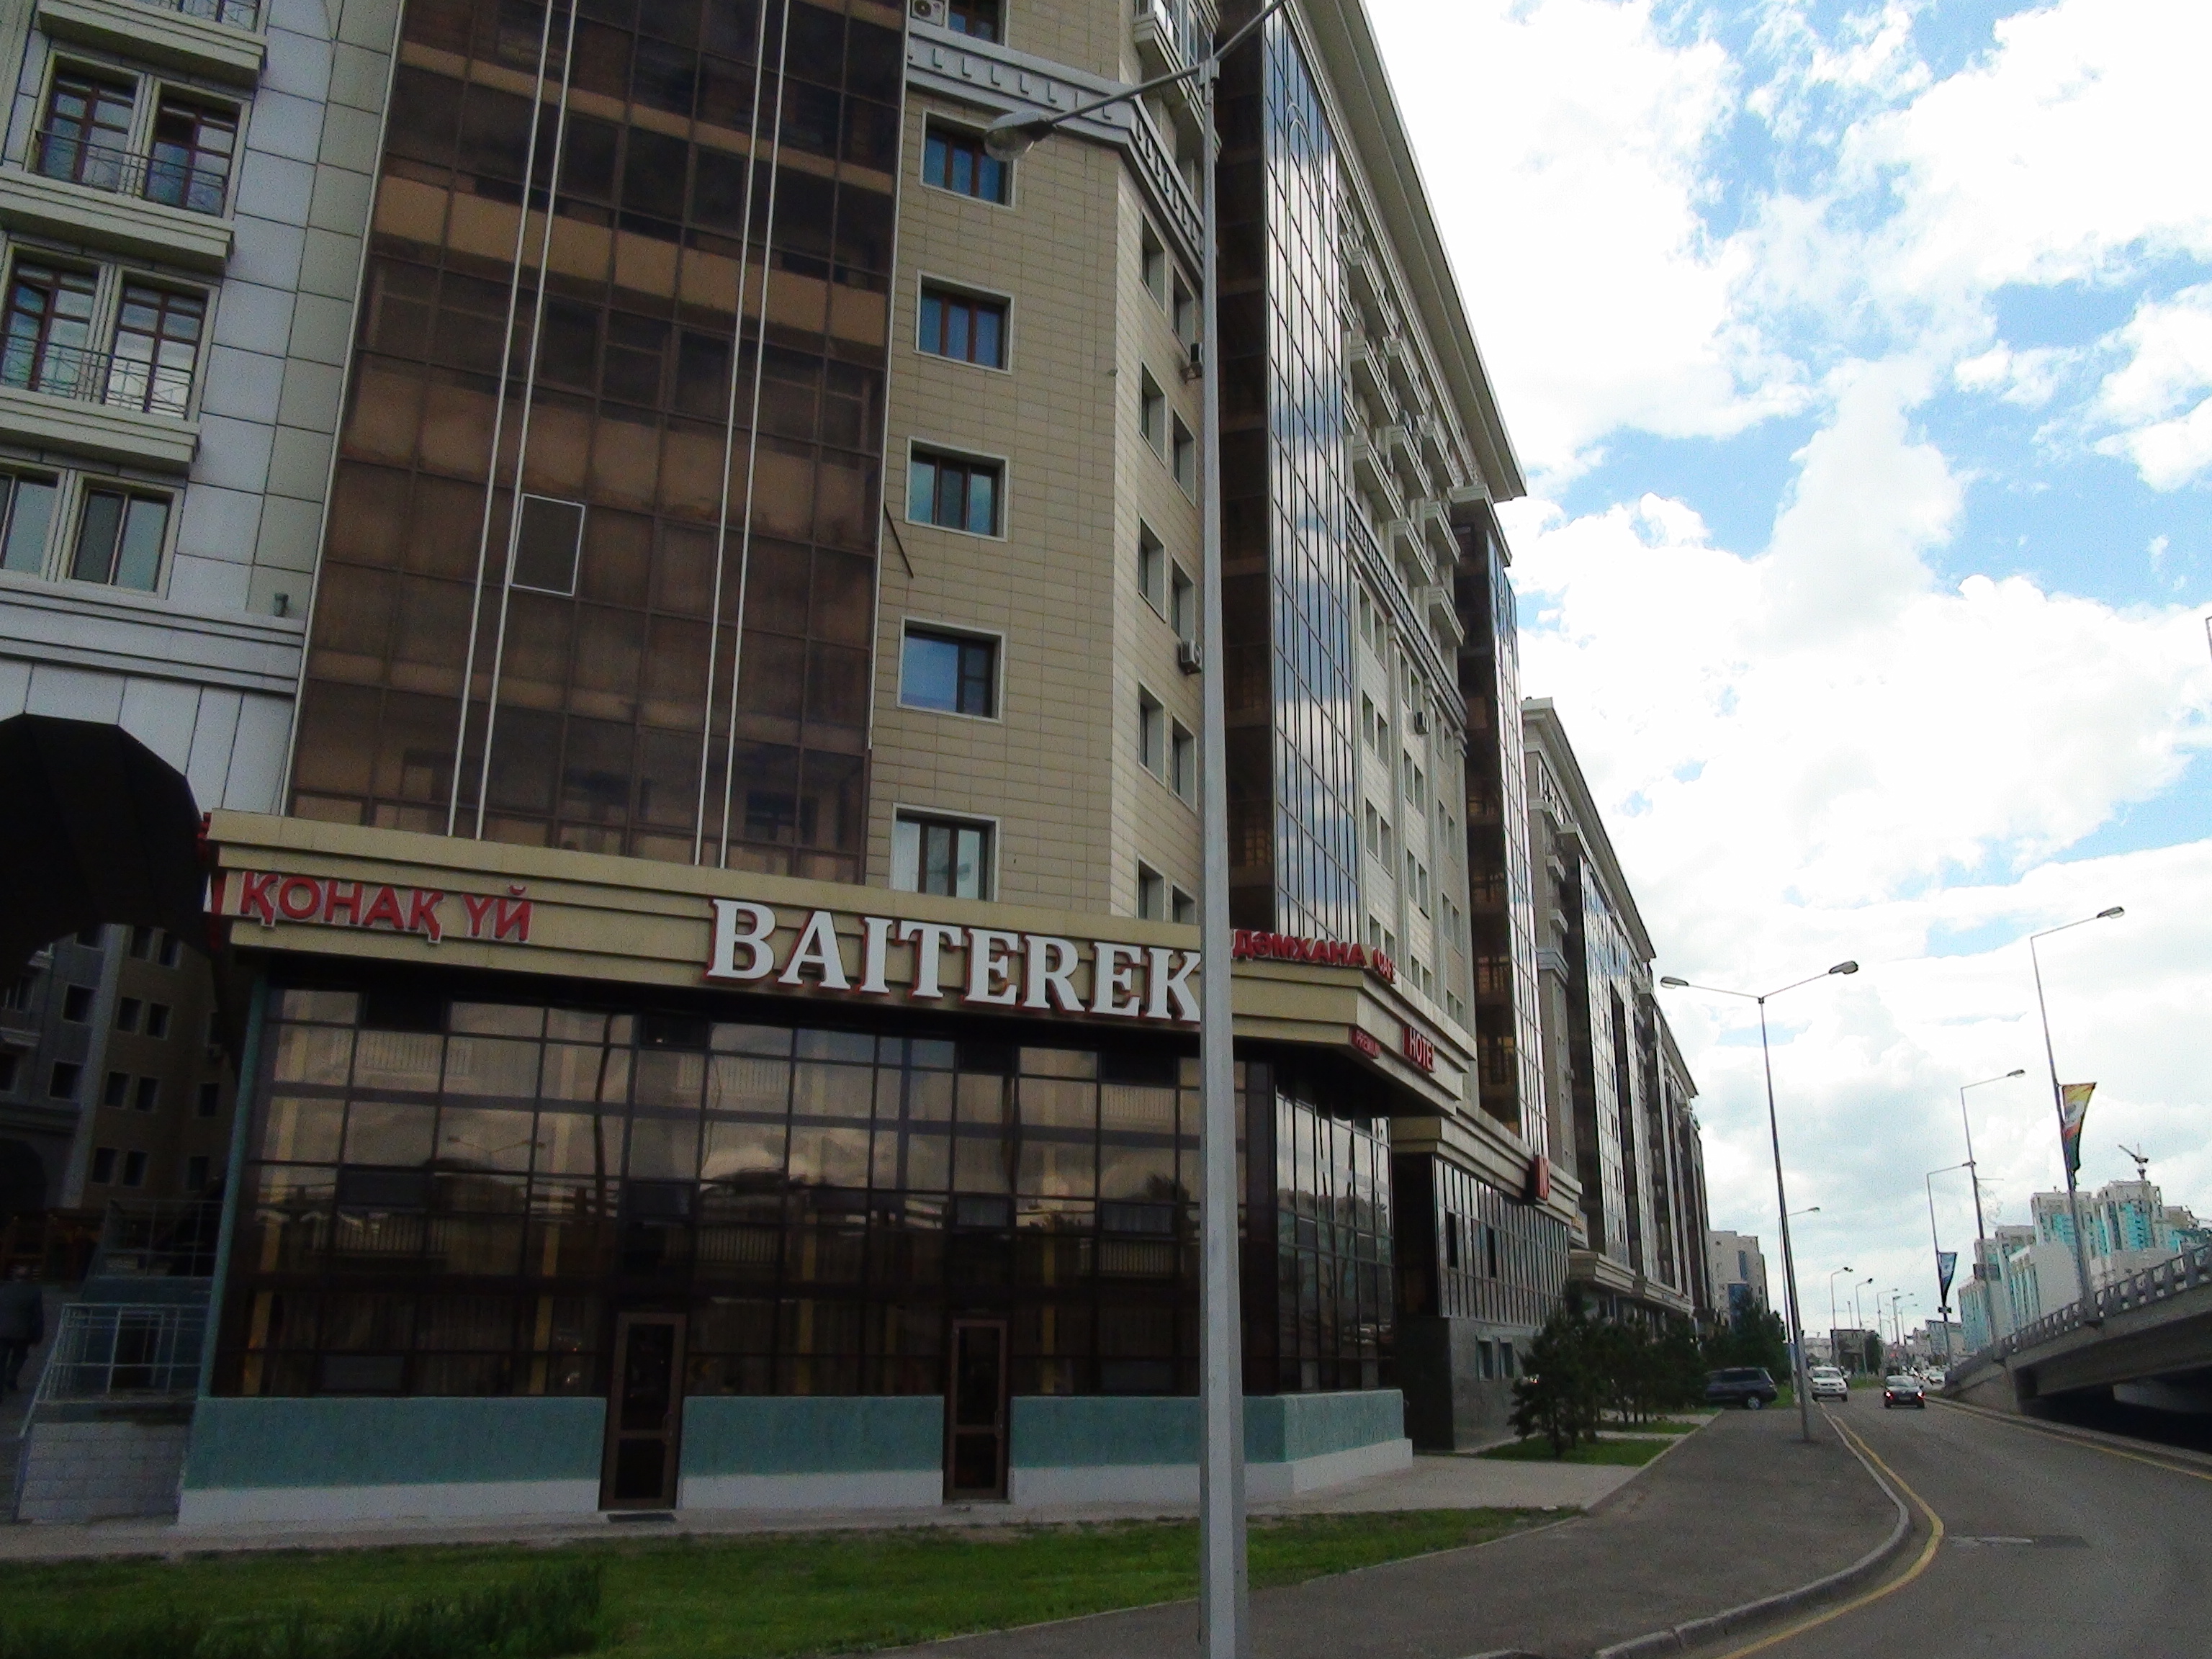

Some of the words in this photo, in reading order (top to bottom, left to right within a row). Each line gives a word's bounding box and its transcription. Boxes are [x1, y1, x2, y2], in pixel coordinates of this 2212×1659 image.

[239, 871, 445, 943] ҚОНАҚ
[462, 884, 533, 943] ҮЙ
[706, 899, 1200, 1022] BAITEREK
[1231, 929, 1367, 968] ДӘМХАНА
